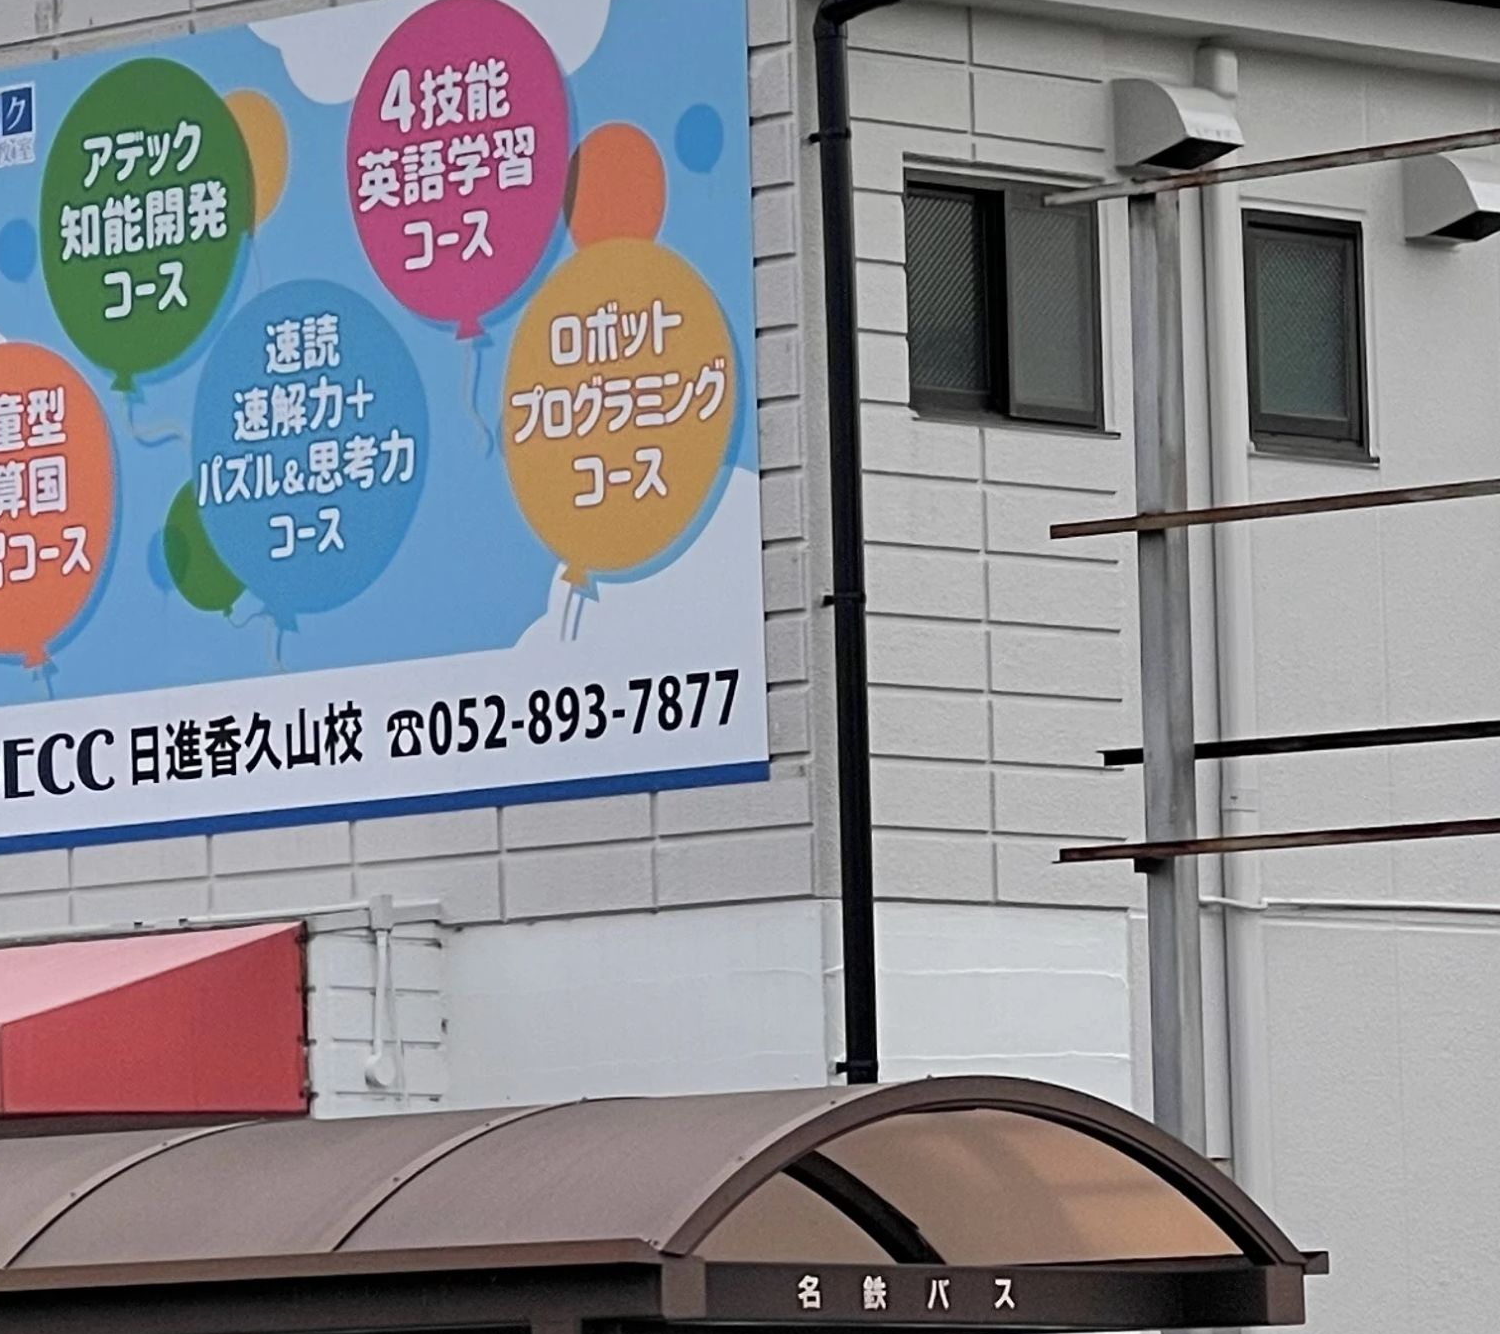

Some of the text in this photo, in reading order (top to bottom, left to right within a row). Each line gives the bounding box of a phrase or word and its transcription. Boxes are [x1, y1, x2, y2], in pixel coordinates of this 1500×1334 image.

[380, 58, 510, 133] 4技能
[83, 121, 201, 188] アデック
[357, 126, 535, 212] 英語学習
[61, 180, 228, 260] 知能開発
[404, 210, 493, 271] コース
[104, 261, 188, 319] コース
[266, 313, 340, 374] 速読
[551, 300, 682, 365] ロボット
[512, 358, 726, 443] プログラミング
[198, 429, 415, 506] パズル&思考力
[573, 448, 667, 507] コース
[270, 508, 344, 559] コース
[130, 701, 365, 786] 日進香久山校
[429, 669, 740, 756] 052-893-7877
[798, 1275, 1015, 1311] 名鉄バス
